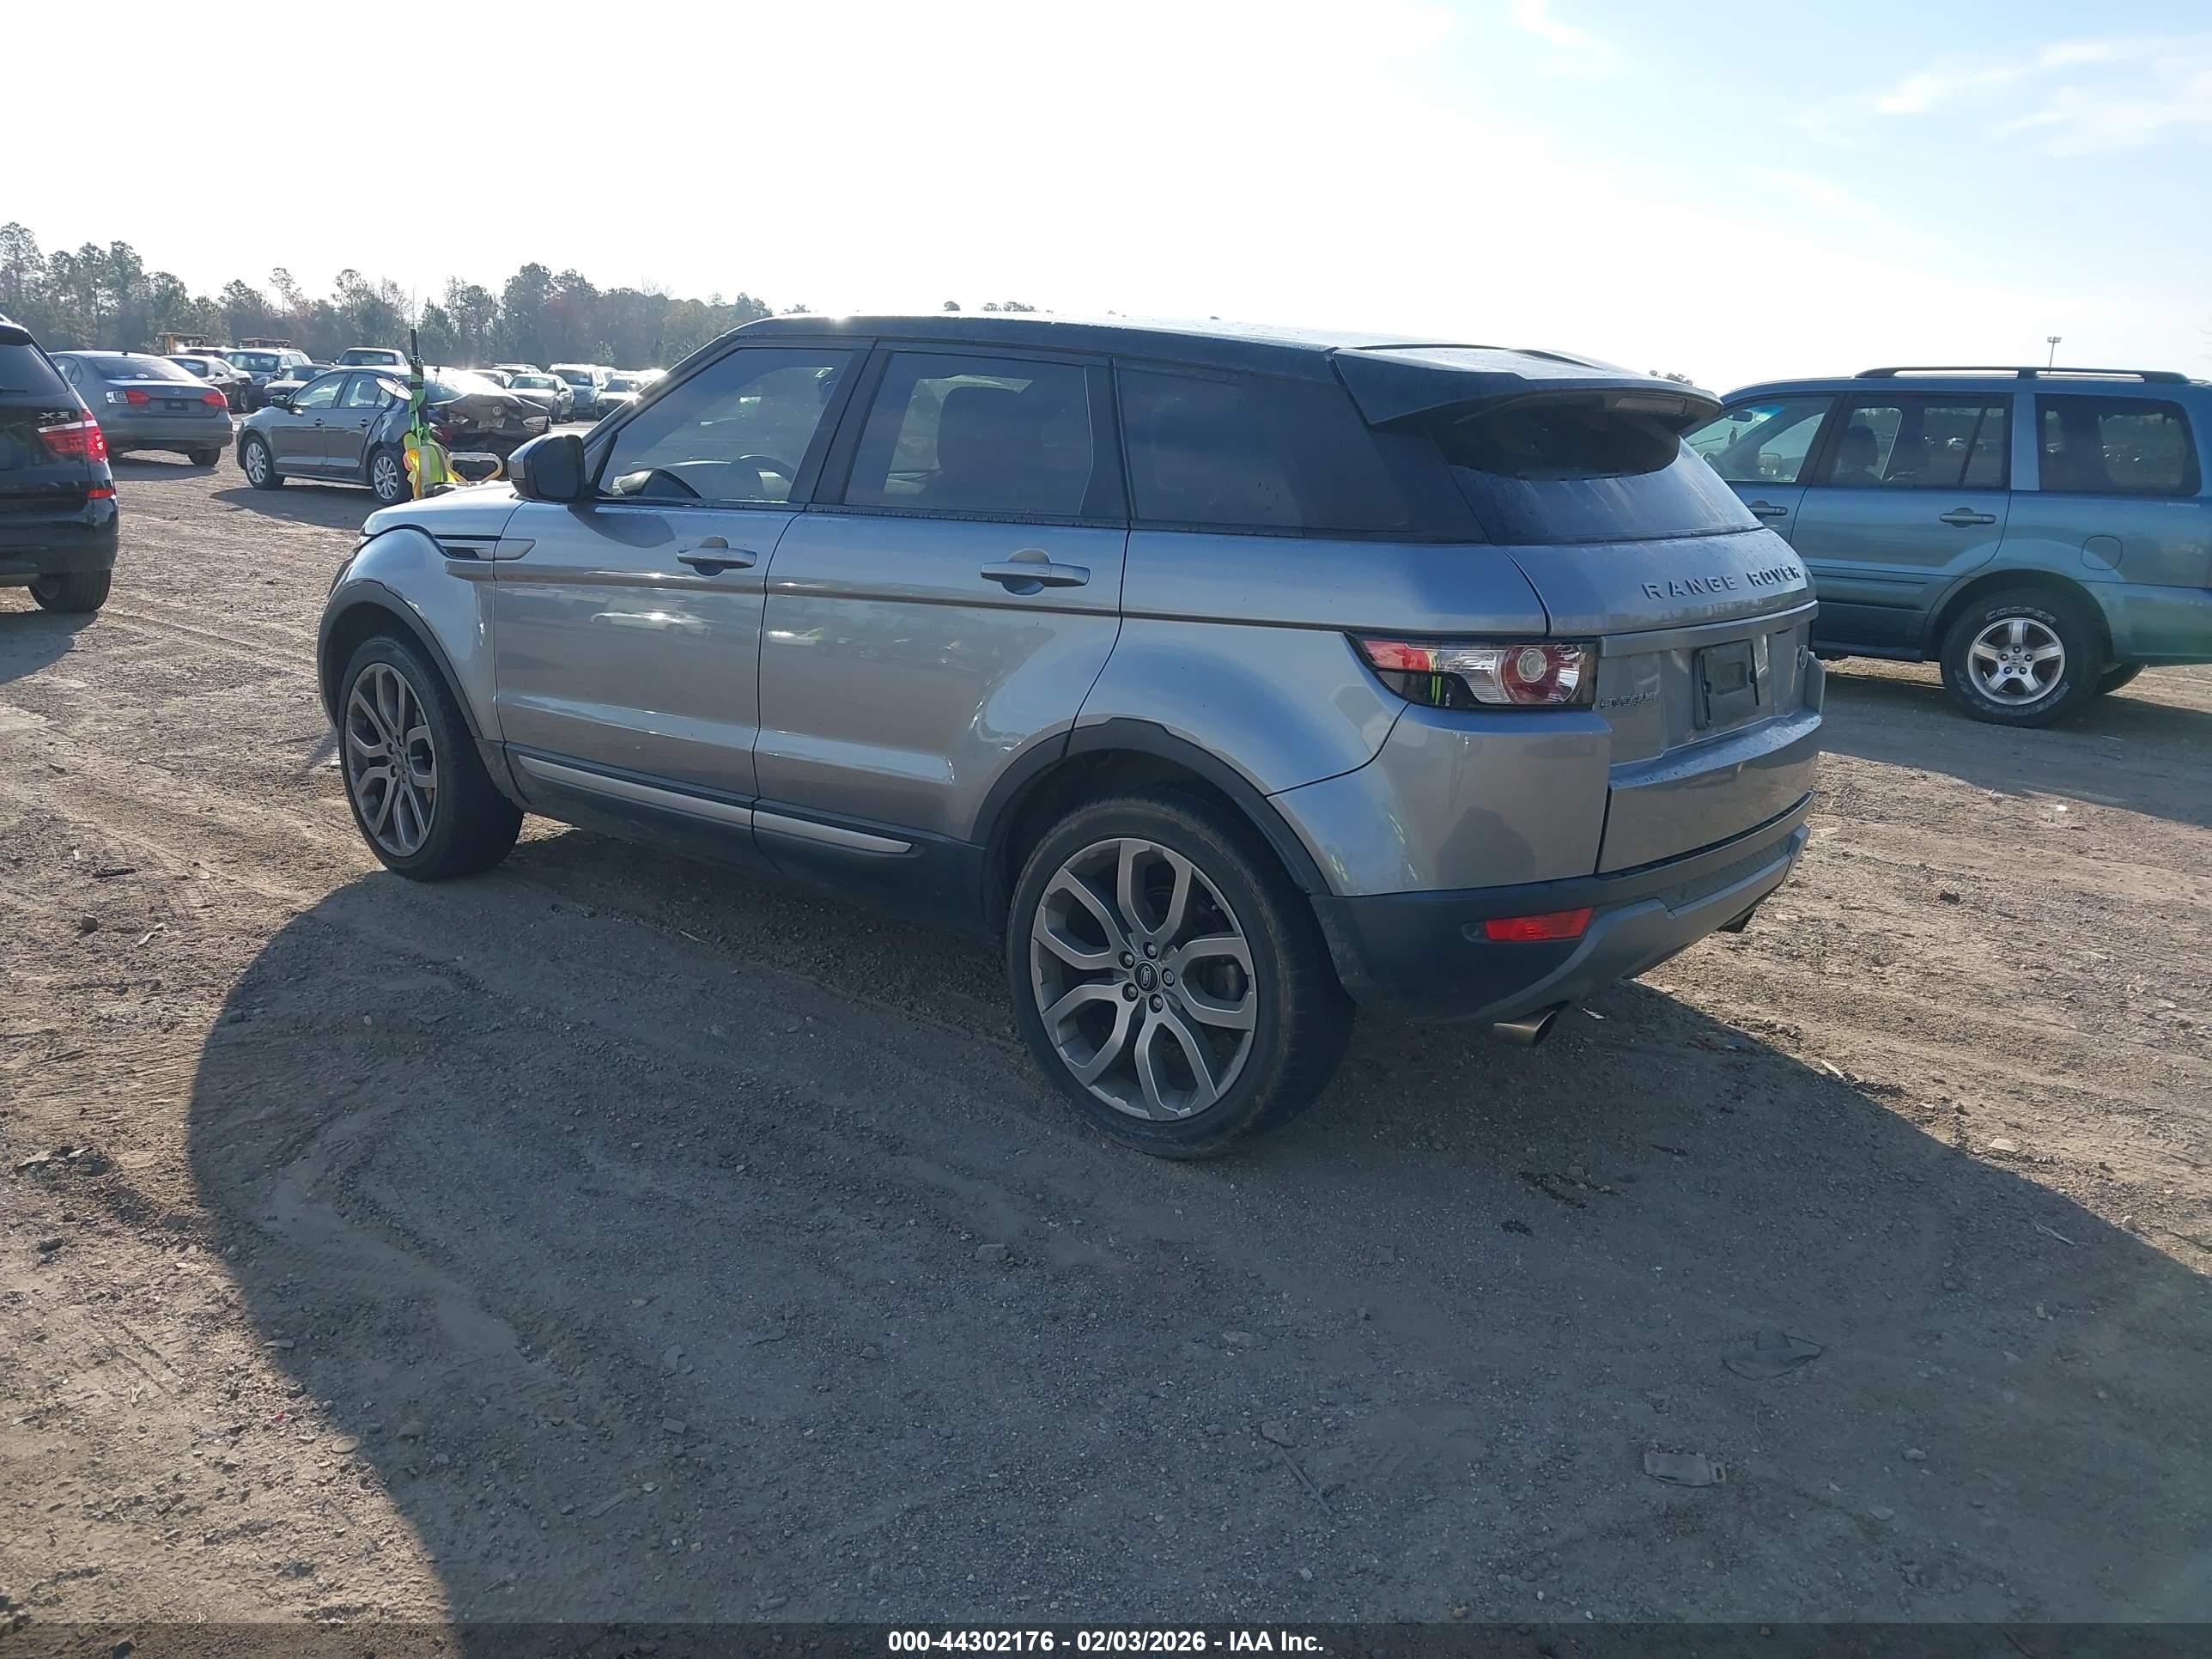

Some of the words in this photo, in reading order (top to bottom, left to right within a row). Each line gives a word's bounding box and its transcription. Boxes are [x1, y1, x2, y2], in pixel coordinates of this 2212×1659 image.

[1641, 574, 1739, 599] RANGE
[1746, 564, 1802, 587] ROVER
[1985, 605, 2057, 623] COOPER
